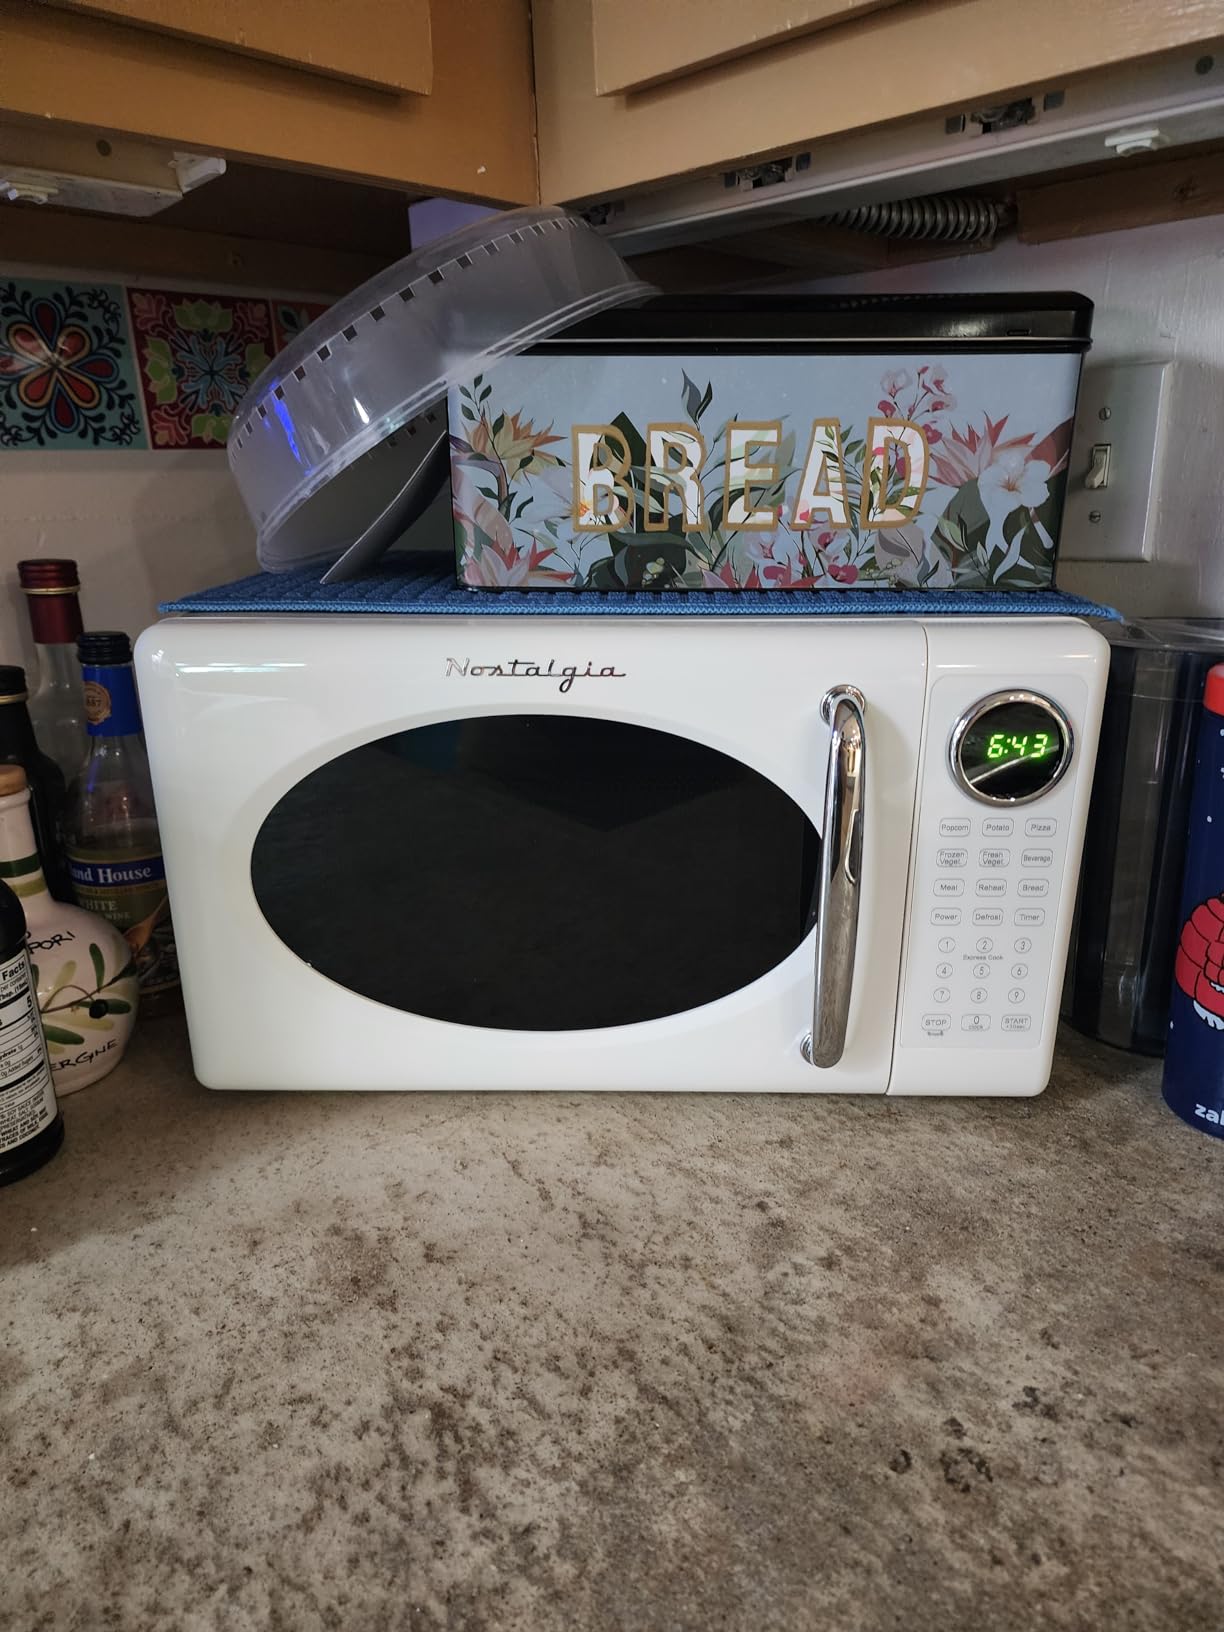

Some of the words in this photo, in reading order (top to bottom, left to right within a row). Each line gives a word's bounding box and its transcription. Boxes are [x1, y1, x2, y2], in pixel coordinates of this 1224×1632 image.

[572, 417, 930, 532] BREAD
[446, 657, 626, 693] Nostalgia
[987, 734, 1048, 758] 6:43
[941, 824, 969, 833] Popcorn
[986, 823, 1010, 831] Potato
[1024, 854, 1051, 863] Beverage
[97, 867, 152, 883] House
[28, 931, 75, 954] PORI
[2, 962, 25, 981] Facts
[27, 996, 33, 1008] 5
[50, 1039, 118, 1072] ERGINE
